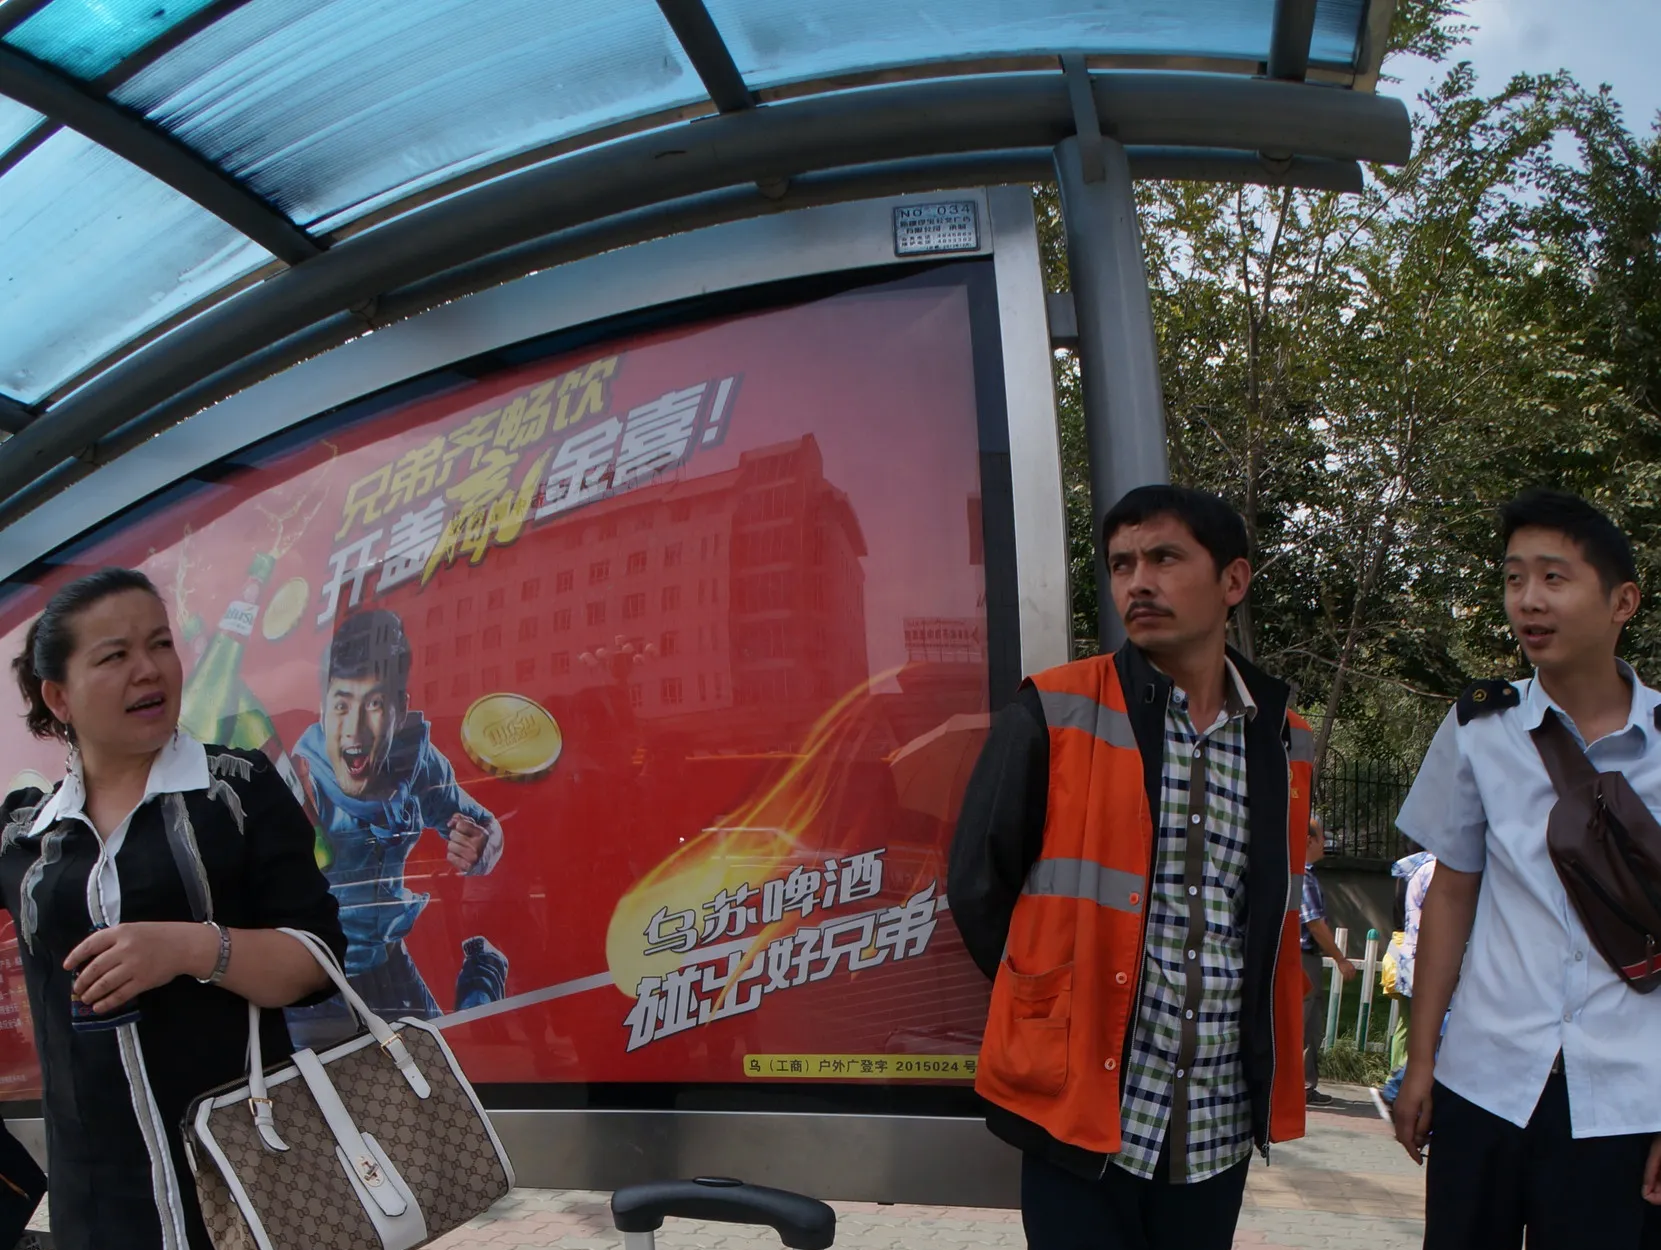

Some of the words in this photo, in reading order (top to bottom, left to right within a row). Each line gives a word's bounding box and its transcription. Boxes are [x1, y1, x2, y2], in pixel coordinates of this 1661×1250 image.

[937, 204, 971, 215] 034
[334, 356, 620, 541] 兄弟齐畅饮
[643, 848, 886, 956] 乌苏啤酒
[622, 880, 938, 1053] 碰出好兄弟
[896, 1060, 959, 1072] 2015024
[963, 1059, 978, 1074] 号
